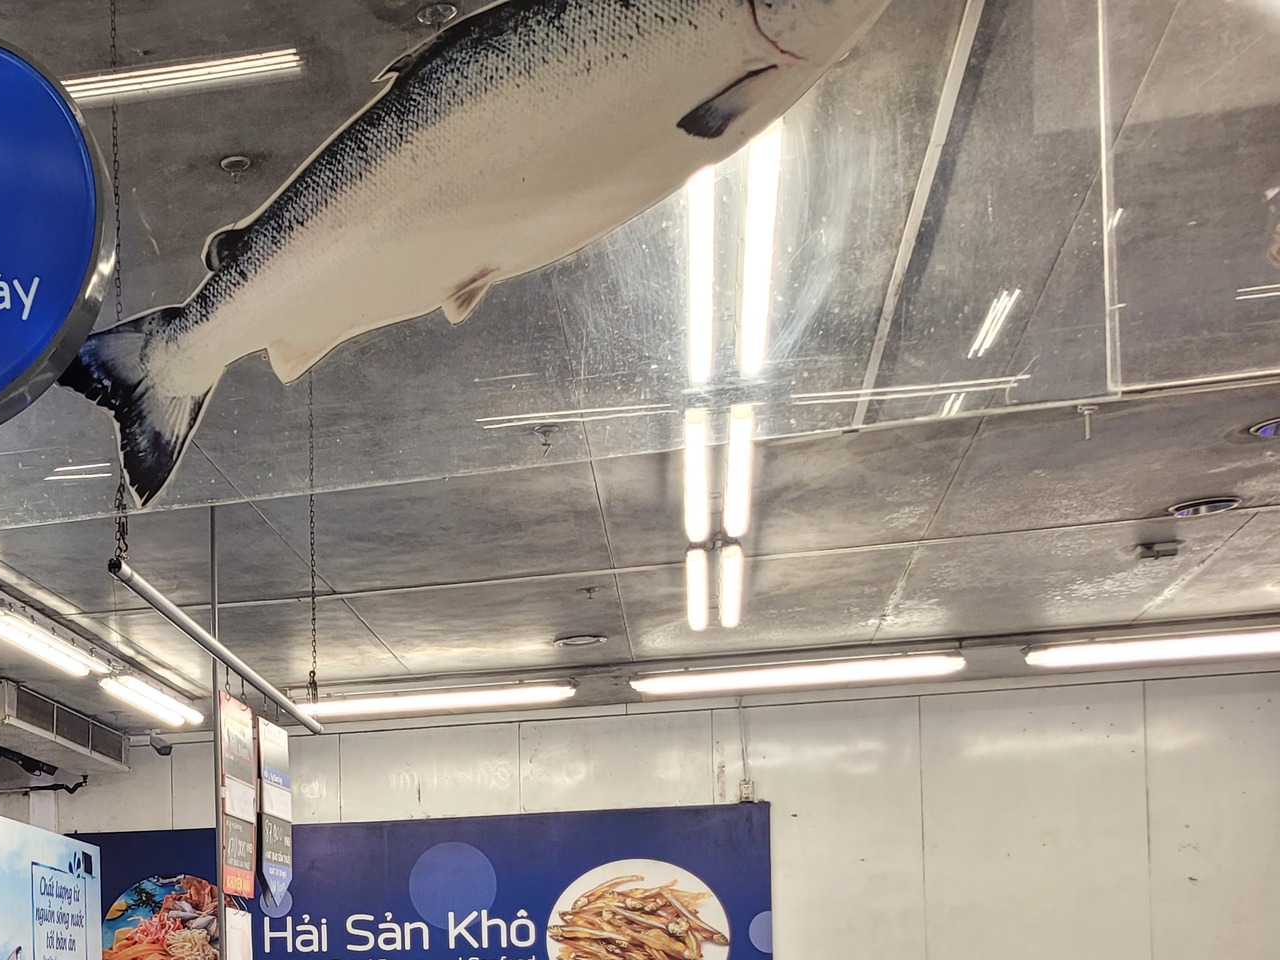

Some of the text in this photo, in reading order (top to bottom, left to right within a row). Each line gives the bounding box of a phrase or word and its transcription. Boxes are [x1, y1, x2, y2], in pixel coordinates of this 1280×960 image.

[40, 876, 80, 905] Chất lượng từ
[35, 900, 84, 930] nguồn sông nước
[46, 930, 55, 949] tới
[56, 931, 67, 952] bàn
[264, 909, 536, 953] Hải Sản Khô
